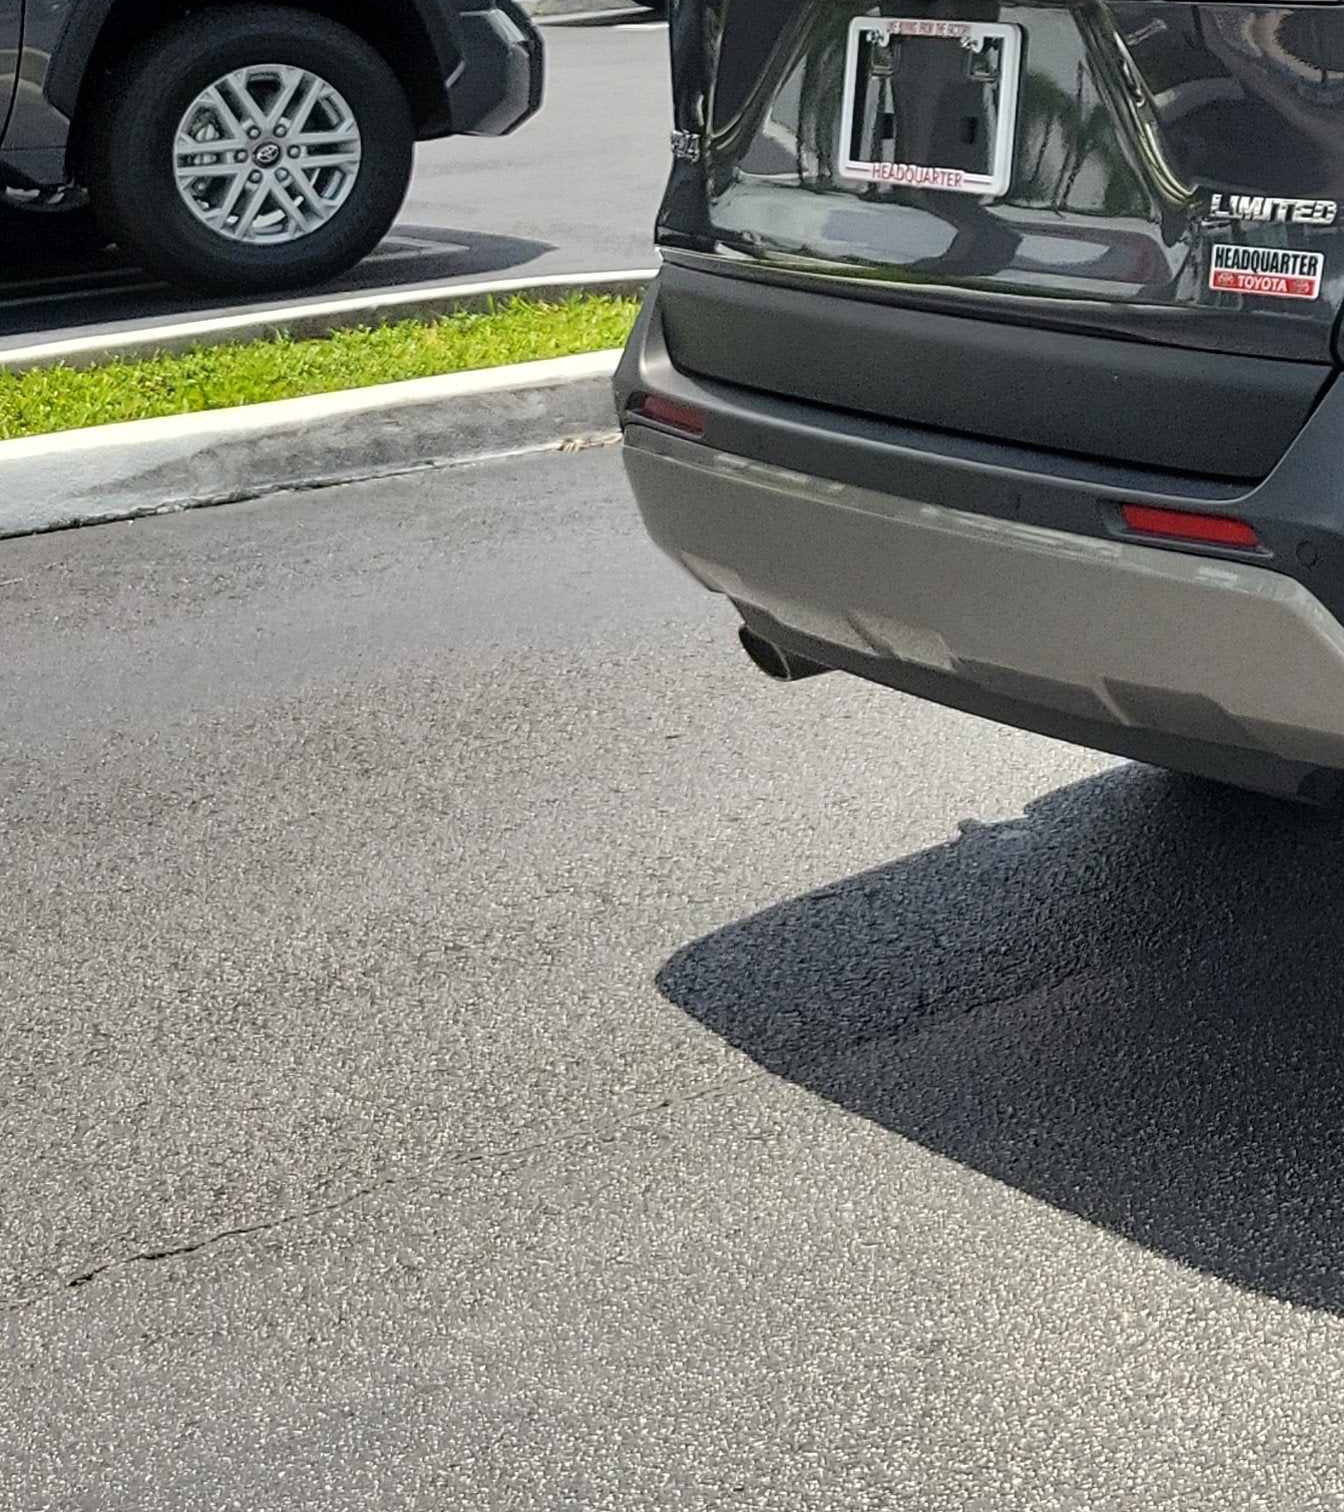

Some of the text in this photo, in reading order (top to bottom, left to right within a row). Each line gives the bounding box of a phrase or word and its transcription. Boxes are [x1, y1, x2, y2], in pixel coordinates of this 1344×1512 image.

[871, 162, 963, 188] HEADQUARTER
[1209, 193, 1338, 225] LIMITED
[1214, 246, 1319, 277] HEADQUARTER
[1238, 275, 1288, 293] TOYOTA
